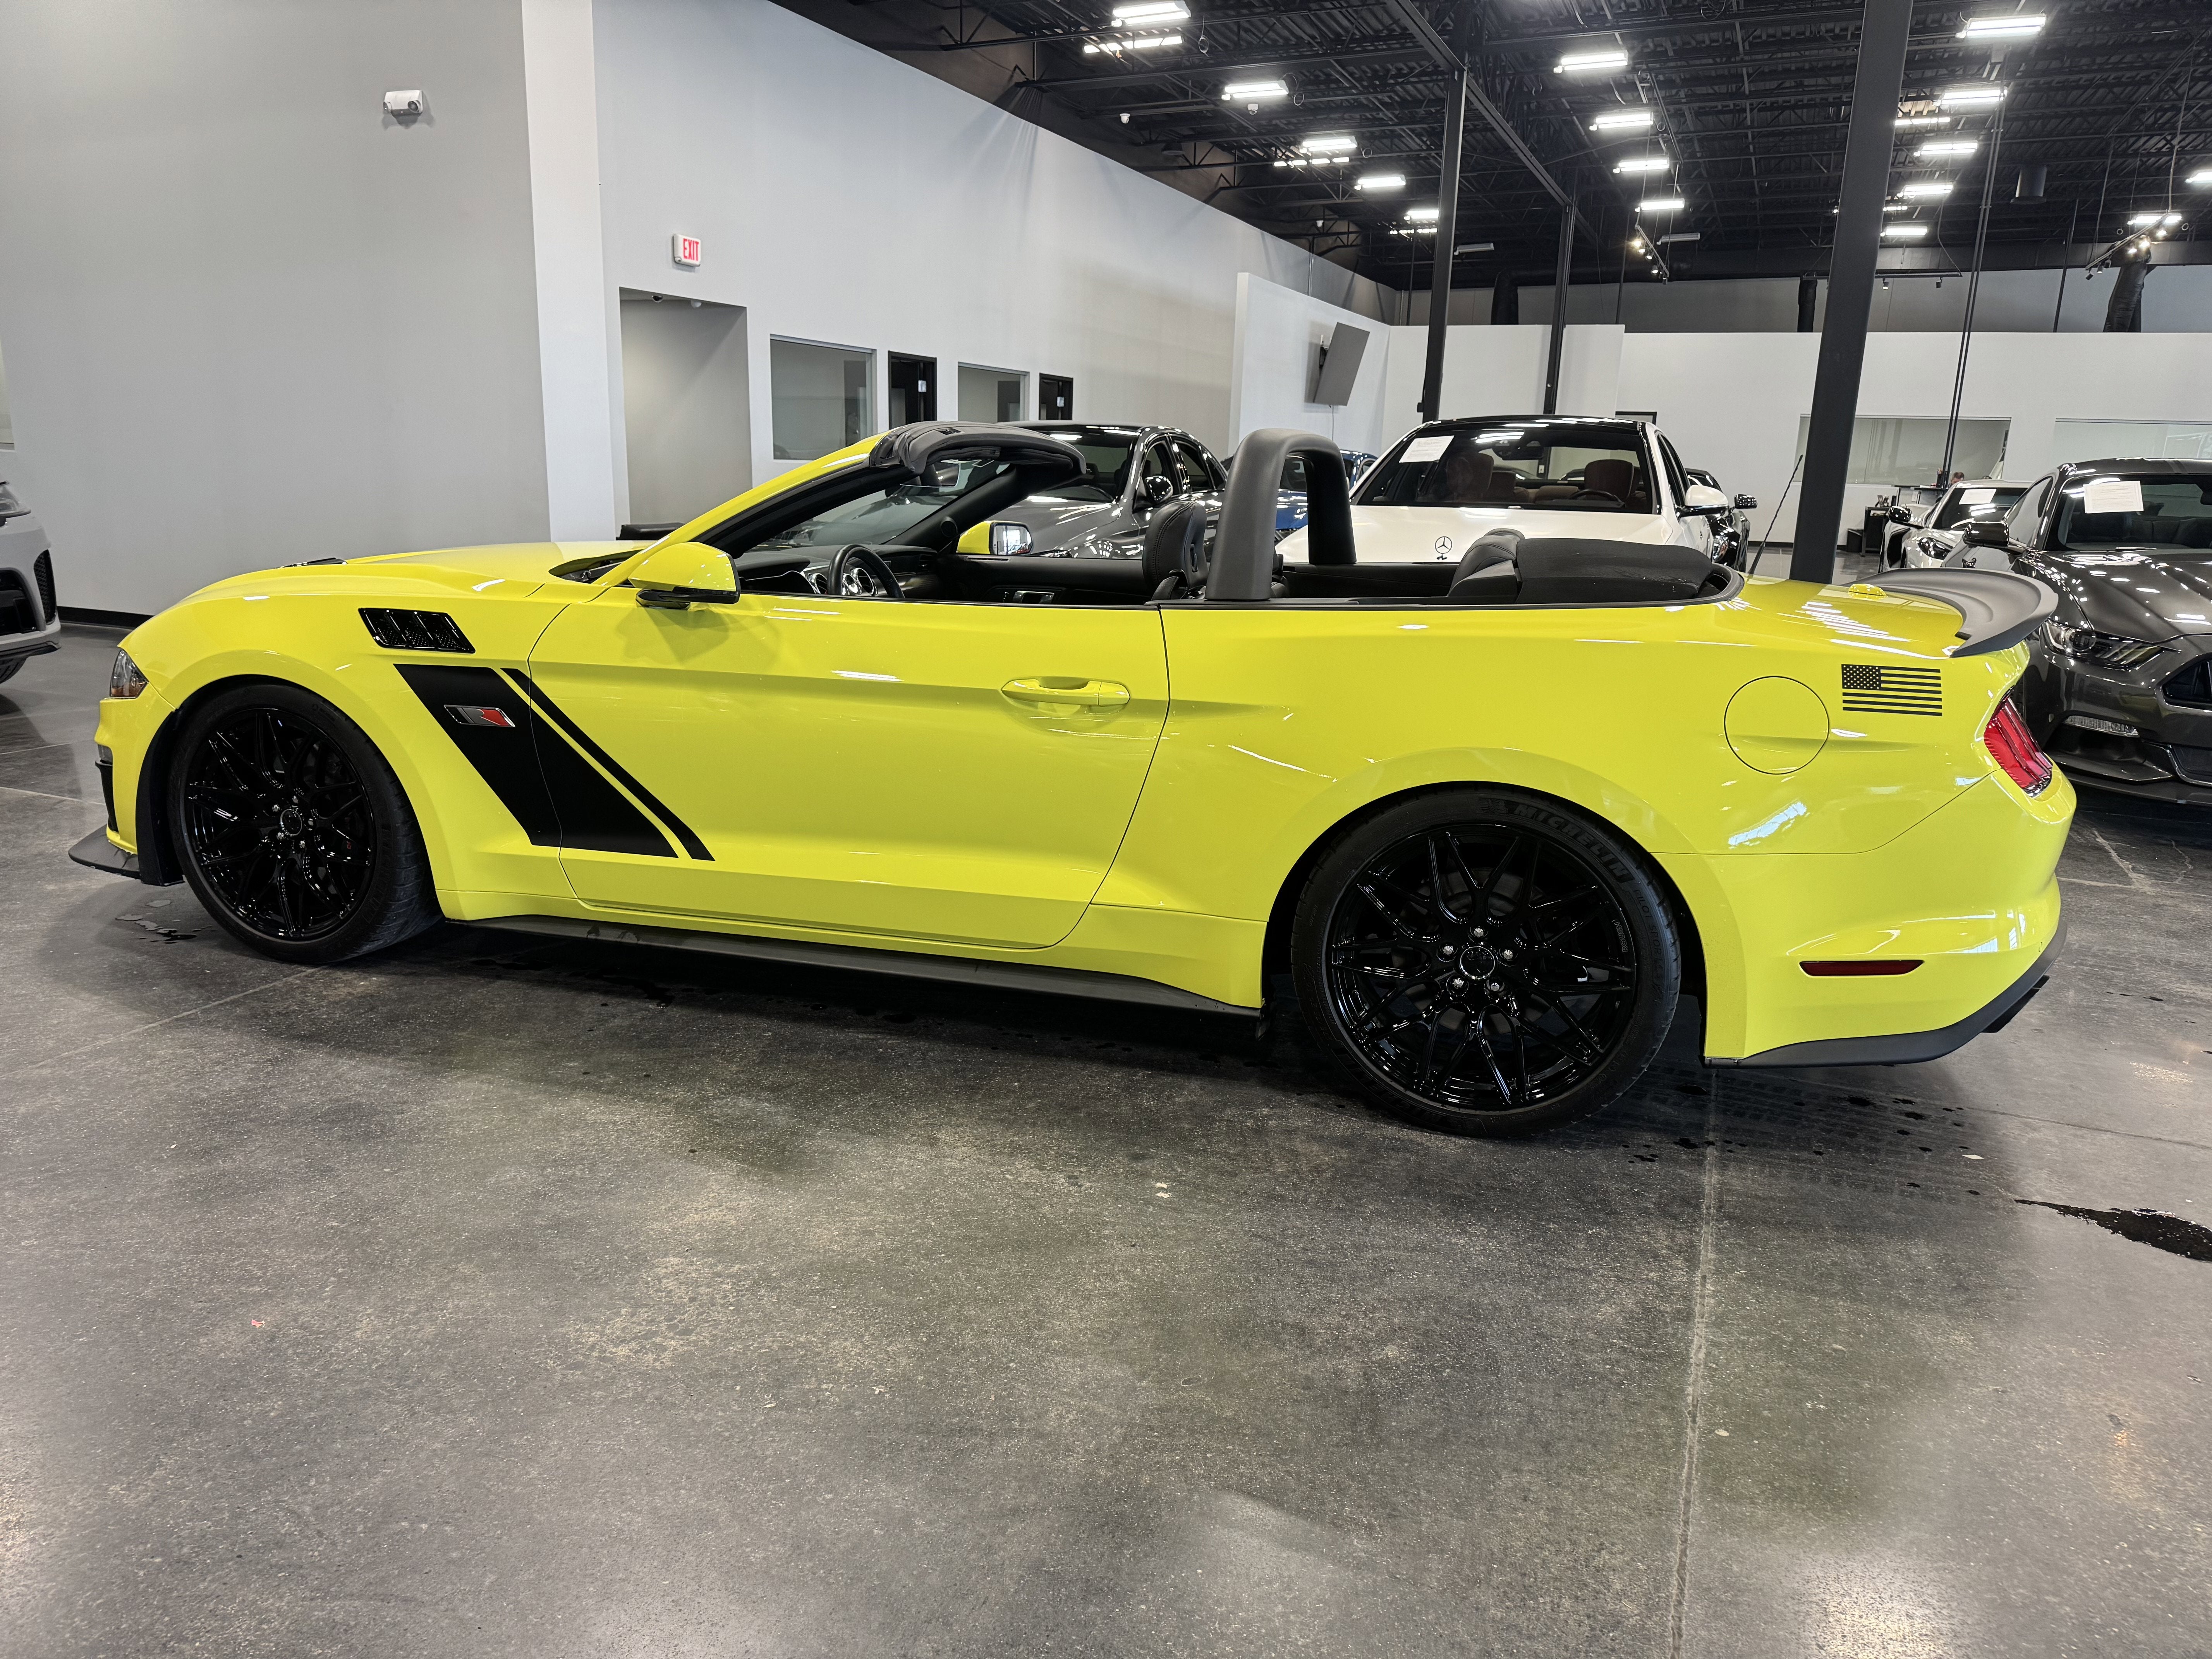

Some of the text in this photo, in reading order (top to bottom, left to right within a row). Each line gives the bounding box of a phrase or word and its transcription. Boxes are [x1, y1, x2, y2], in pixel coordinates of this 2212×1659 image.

[683, 238, 699, 261] EXIT
[1514, 804, 1629, 878] MICHELIN
[1614, 921, 1629, 953] ROUSH
[1633, 889, 1652, 918] PILOT
[1649, 925, 1662, 961] SPORT
